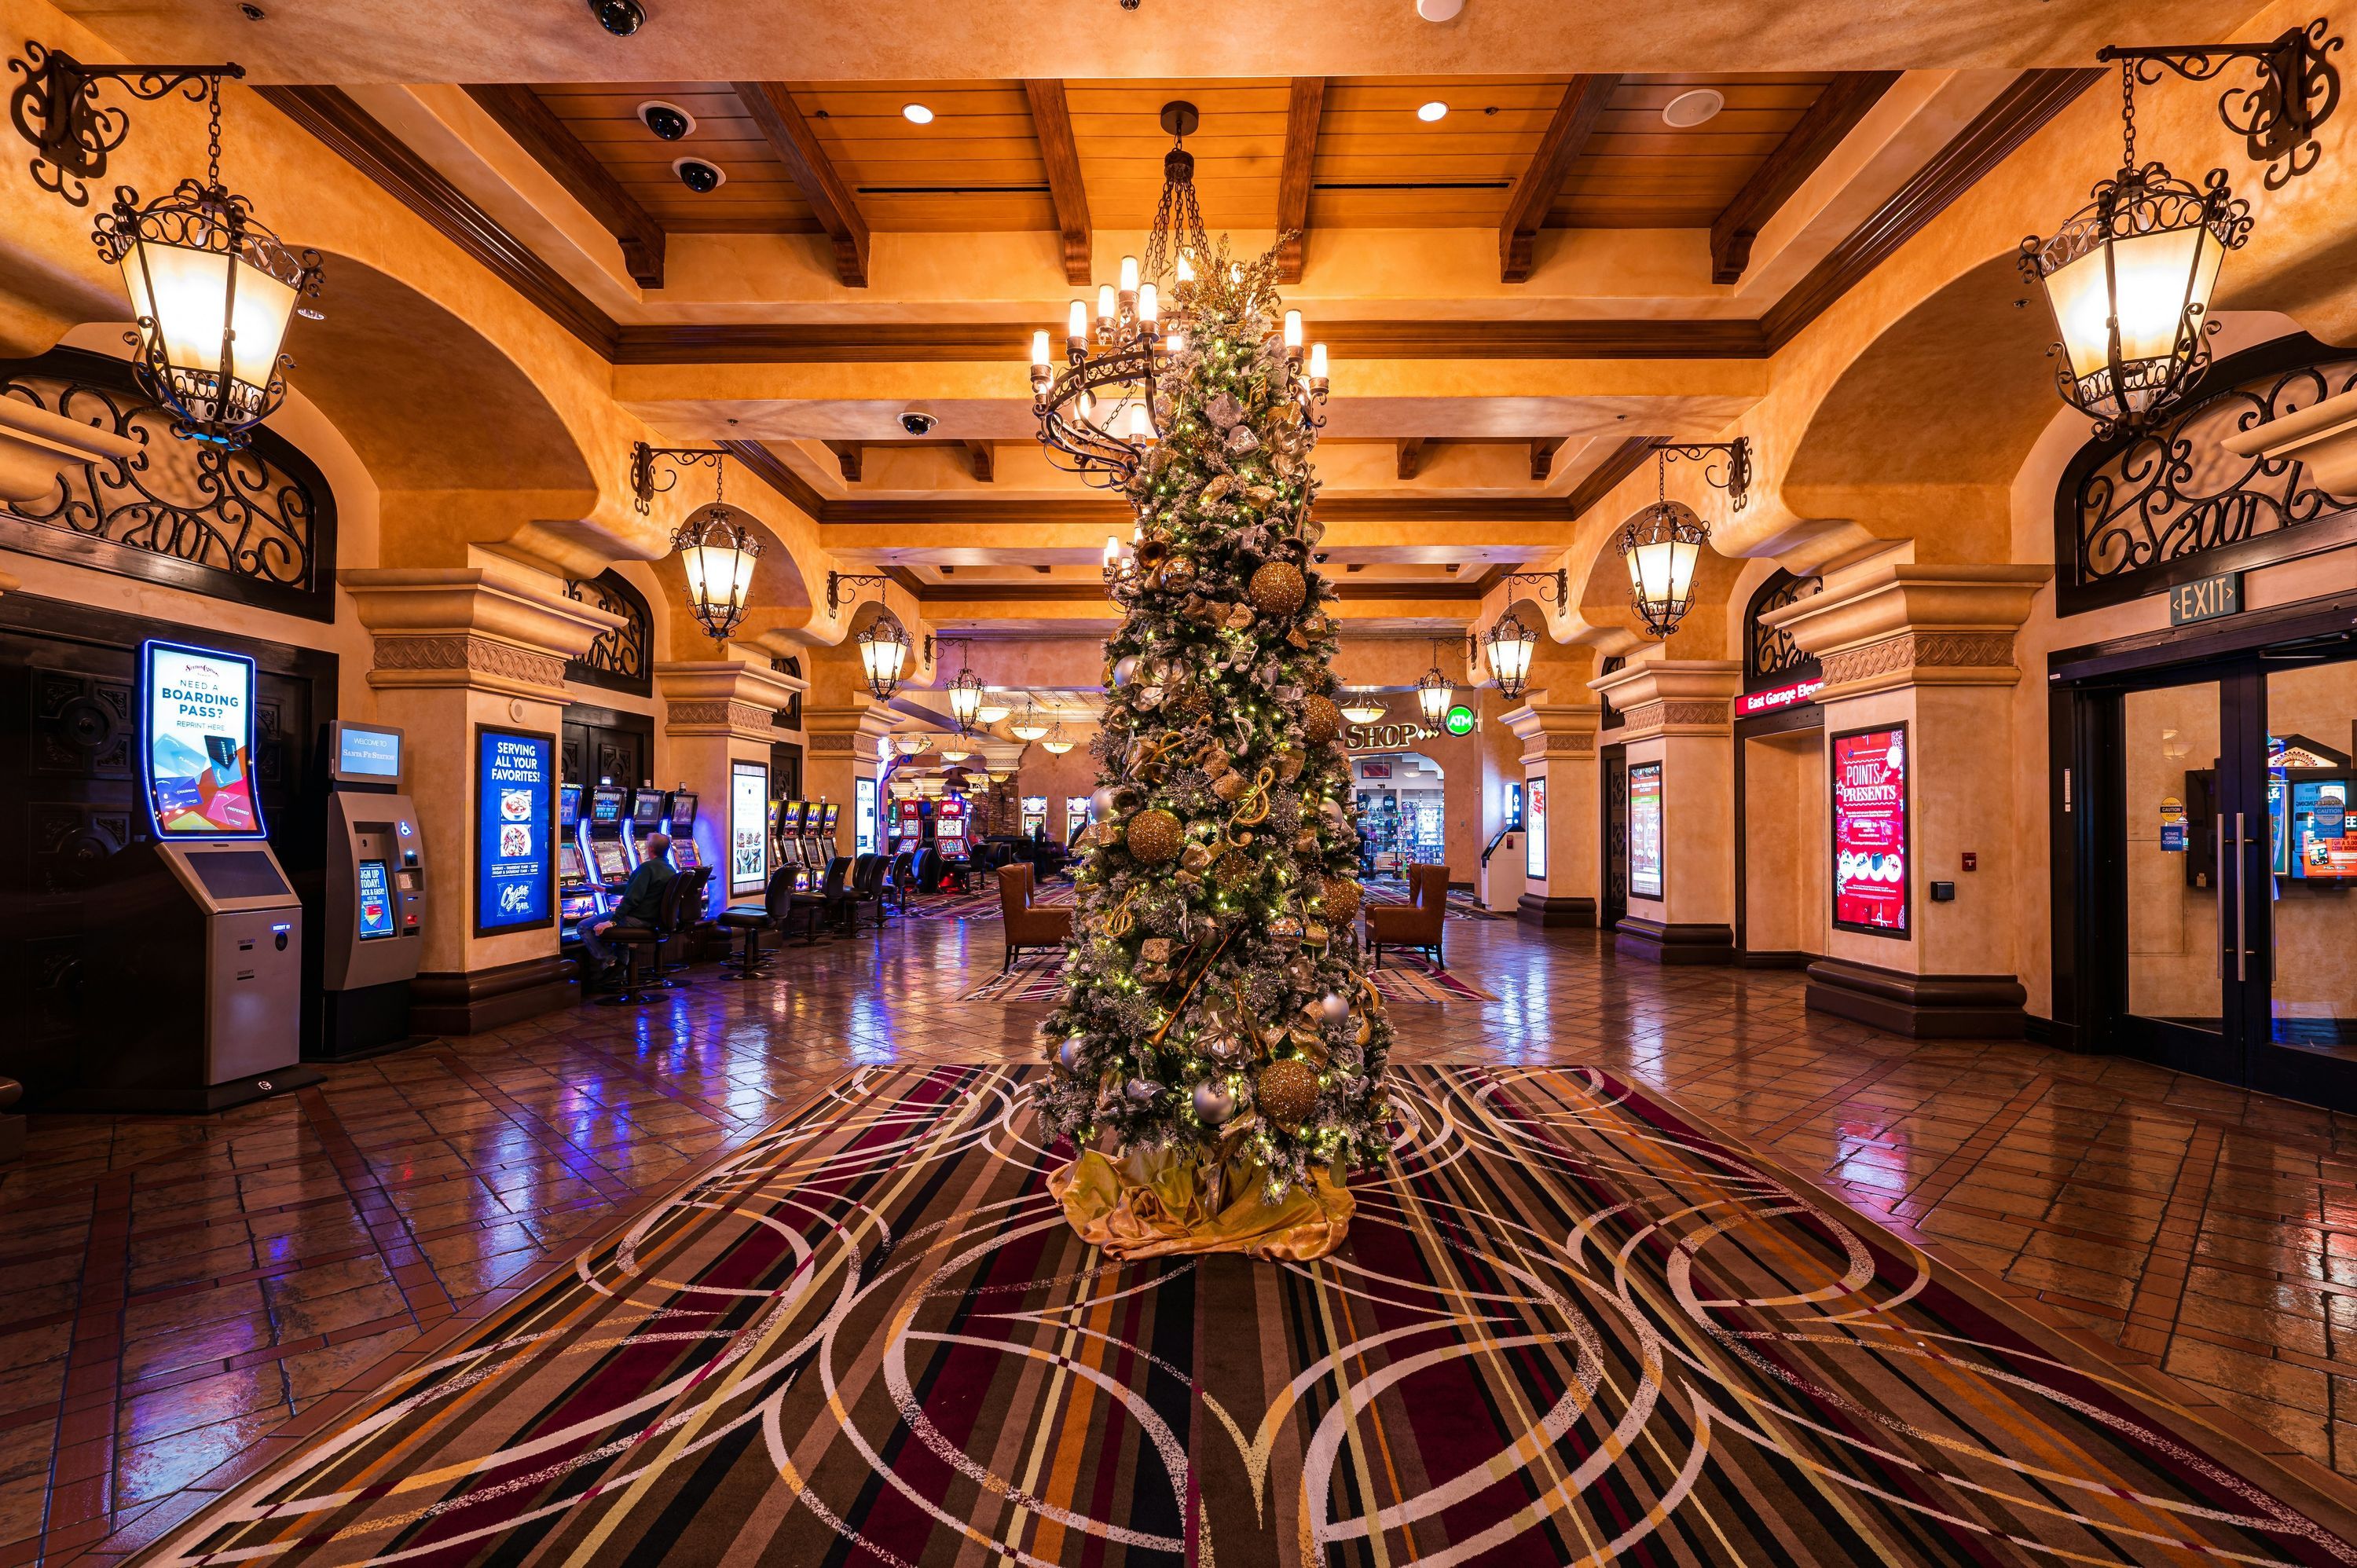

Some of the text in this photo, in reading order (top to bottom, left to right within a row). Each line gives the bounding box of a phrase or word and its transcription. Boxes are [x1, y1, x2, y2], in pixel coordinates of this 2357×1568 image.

[2181, 577, 2227, 620] EXIT
[180, 680, 207, 690] NEED
[162, 687, 239, 707] BOARDING
[1748, 696, 1765, 710] East
[1765, 689, 1796, 705] Garage
[179, 704, 223, 718] PASS?
[176, 720, 206, 729] REPRINT
[1448, 715, 1472, 727] ATM
[354, 738, 379, 747] WELCOME
[1343, 723, 1417, 749] SHOP
[343, 749, 362, 758] SANTA
[372, 752, 396, 761] STATION
[497, 742, 536, 757] SERVING
[494, 755, 537, 770] ALL YOUR
[491, 768, 541, 782] FAVORITES!
[1846, 763, 1880, 786] POINTS
[1842, 785, 1897, 802] PRESENTS
[227, 806, 250, 815] PREFERRED
[372, 870, 379, 878] UP
[361, 879, 380, 888] TODAY!
[500, 883, 530, 913] Oyster
